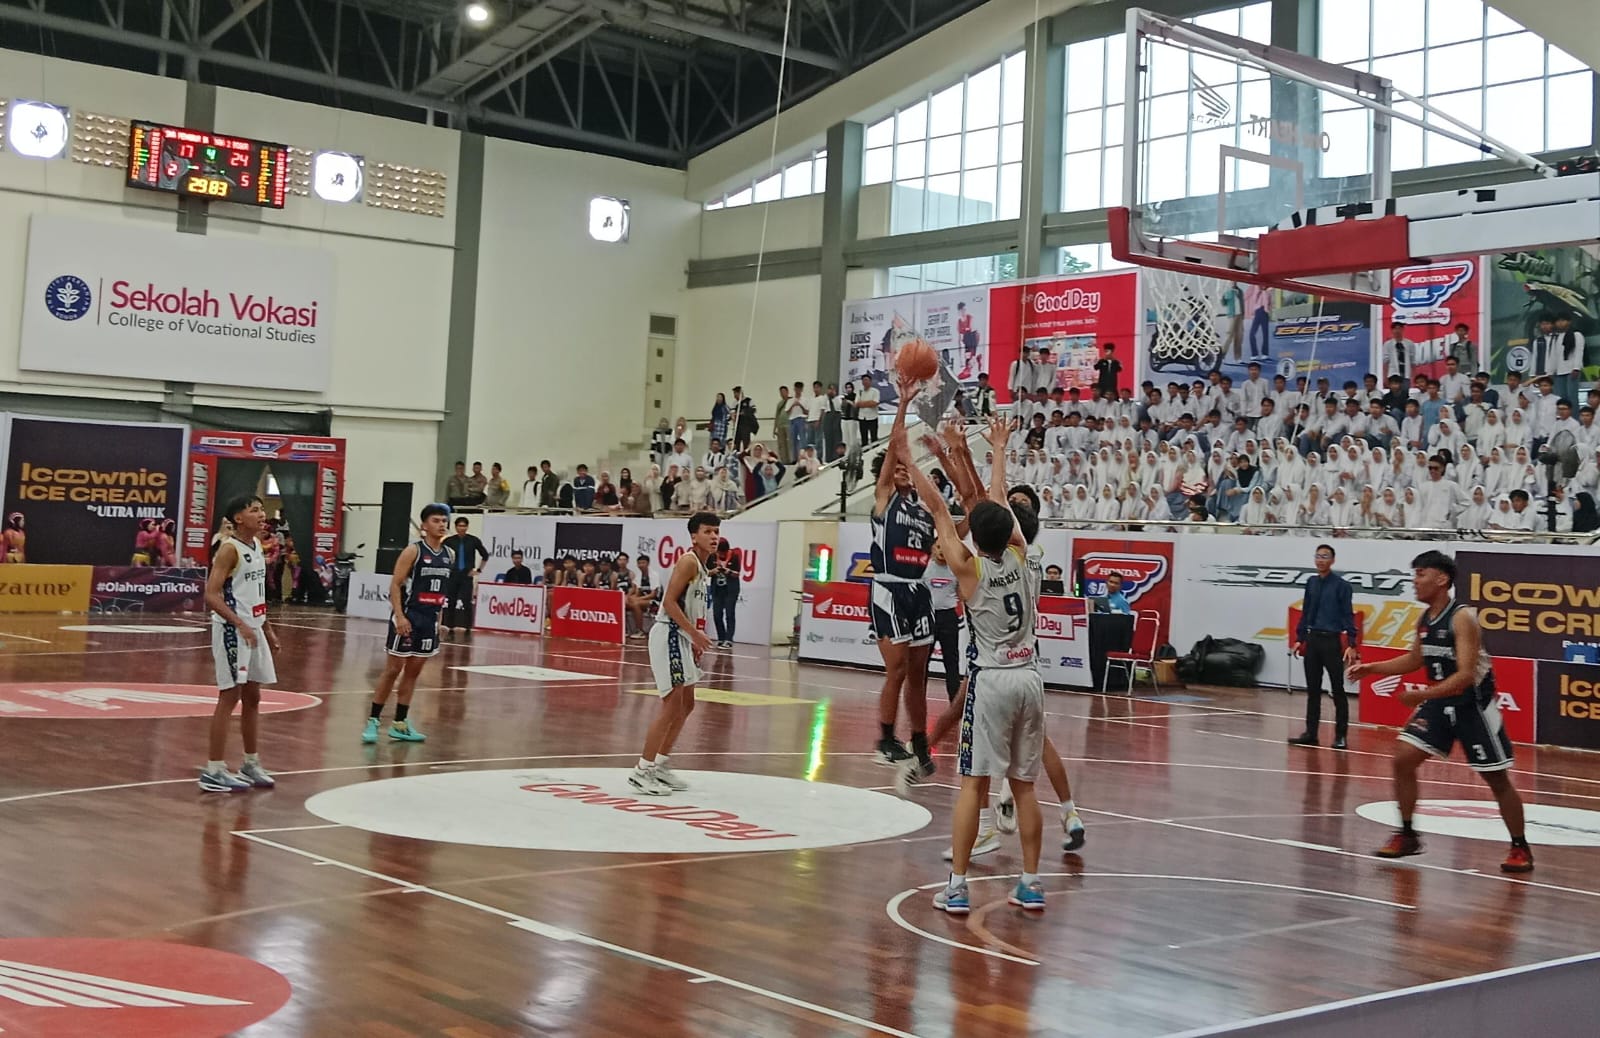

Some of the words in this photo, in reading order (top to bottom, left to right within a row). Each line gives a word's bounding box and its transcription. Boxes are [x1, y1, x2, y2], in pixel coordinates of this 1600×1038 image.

[230, 152, 249, 166] 24
[167, 164, 178, 176] 2
[110, 280, 220, 318] Sekolah
[229, 292, 318, 328] Vokasi
[108, 312, 164, 331] College
[168, 318, 184, 331] of
[187, 319, 262, 339] Vocational
[265, 327, 316, 344] Studies
[850, 344, 871, 360] BEST
[19, 485, 66, 501] ICE
[69, 487, 167, 504] CREAM
[97, 505, 134, 518] ULTRA
[136, 506, 166, 519] MILK
[96, 582, 199, 595] #OlahragaTikTok
[430, 578, 441, 592] 10
[570, 609, 618, 625] HONDA
[1003, 592, 1023, 633] 9
[1477, 607, 1530, 632] CE
[1536, 611, 1600, 637] CR
